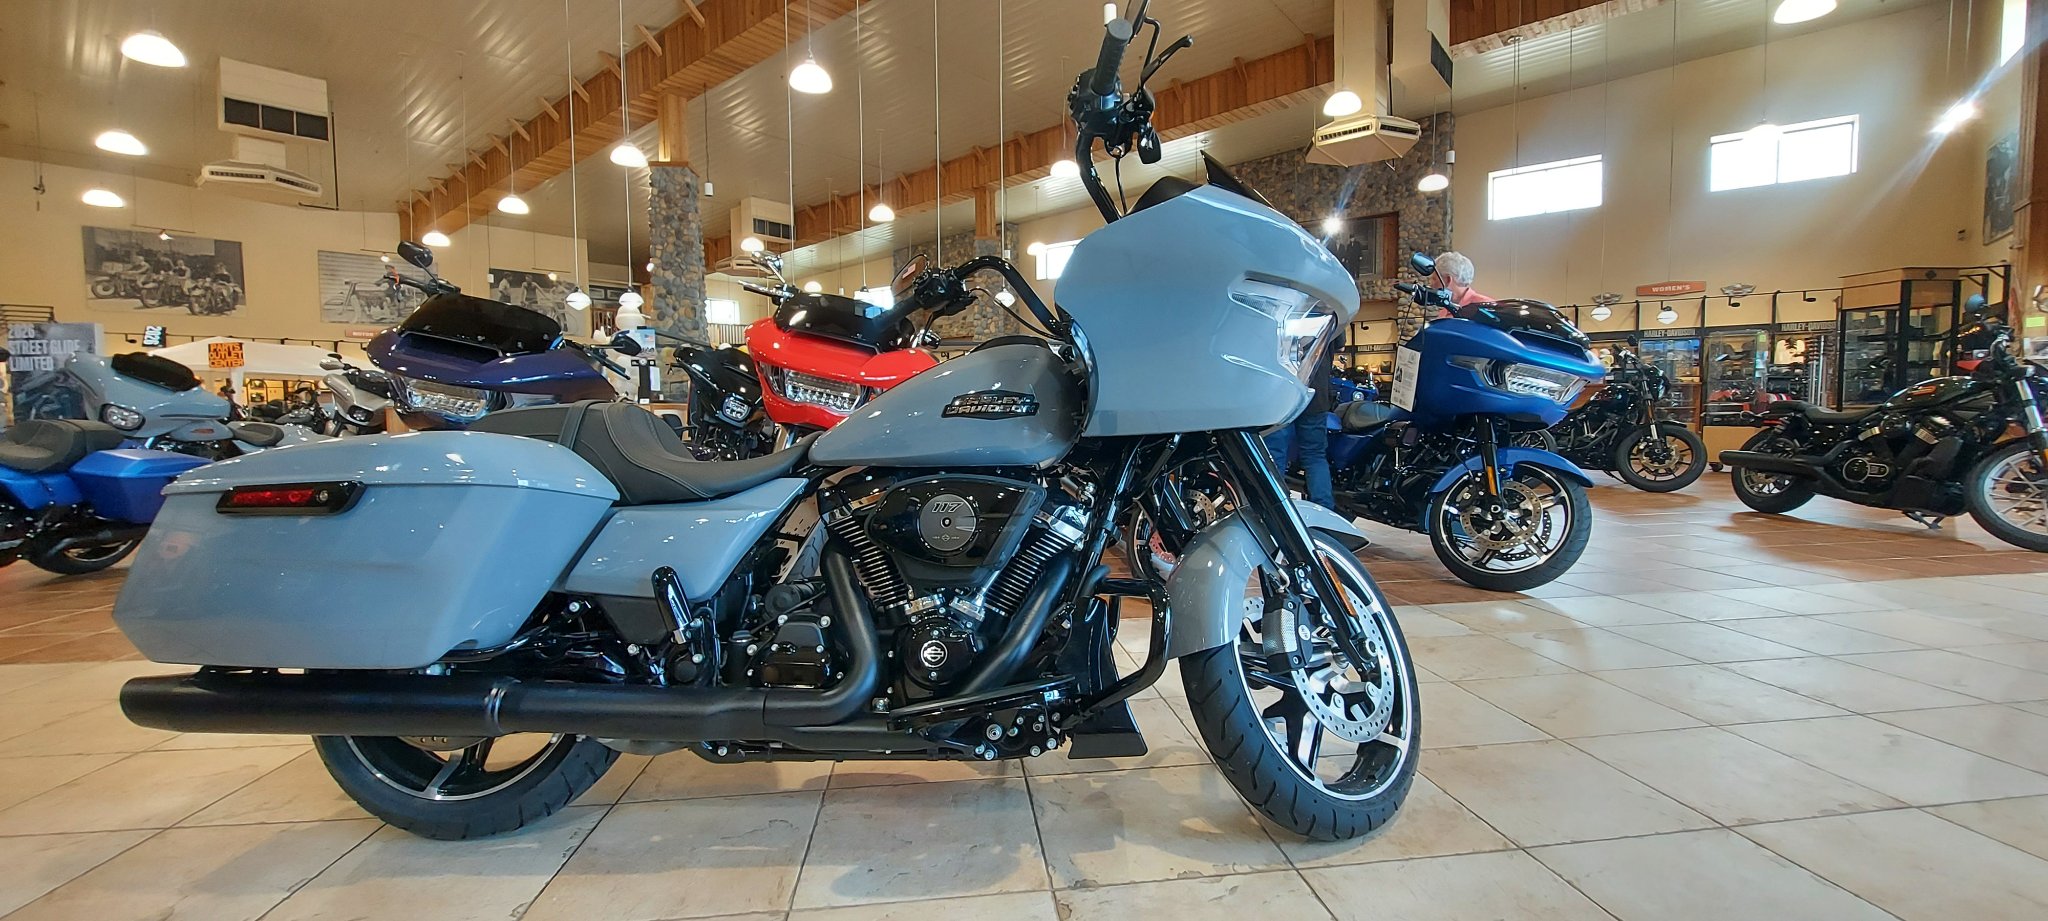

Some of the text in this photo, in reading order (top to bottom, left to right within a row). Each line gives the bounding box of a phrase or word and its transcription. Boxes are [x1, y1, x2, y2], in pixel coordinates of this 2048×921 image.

[1651, 285, 1691, 293] WOMEN'S
[8, 324, 35, 338] 2026
[8, 340, 49, 354] STREET
[210, 343, 240, 352] PARTS
[209, 352, 242, 360] OUTLET
[9, 356, 54, 371] LIMITED
[209, 360, 244, 368] CENTER
[931, 501, 964, 513] 117
